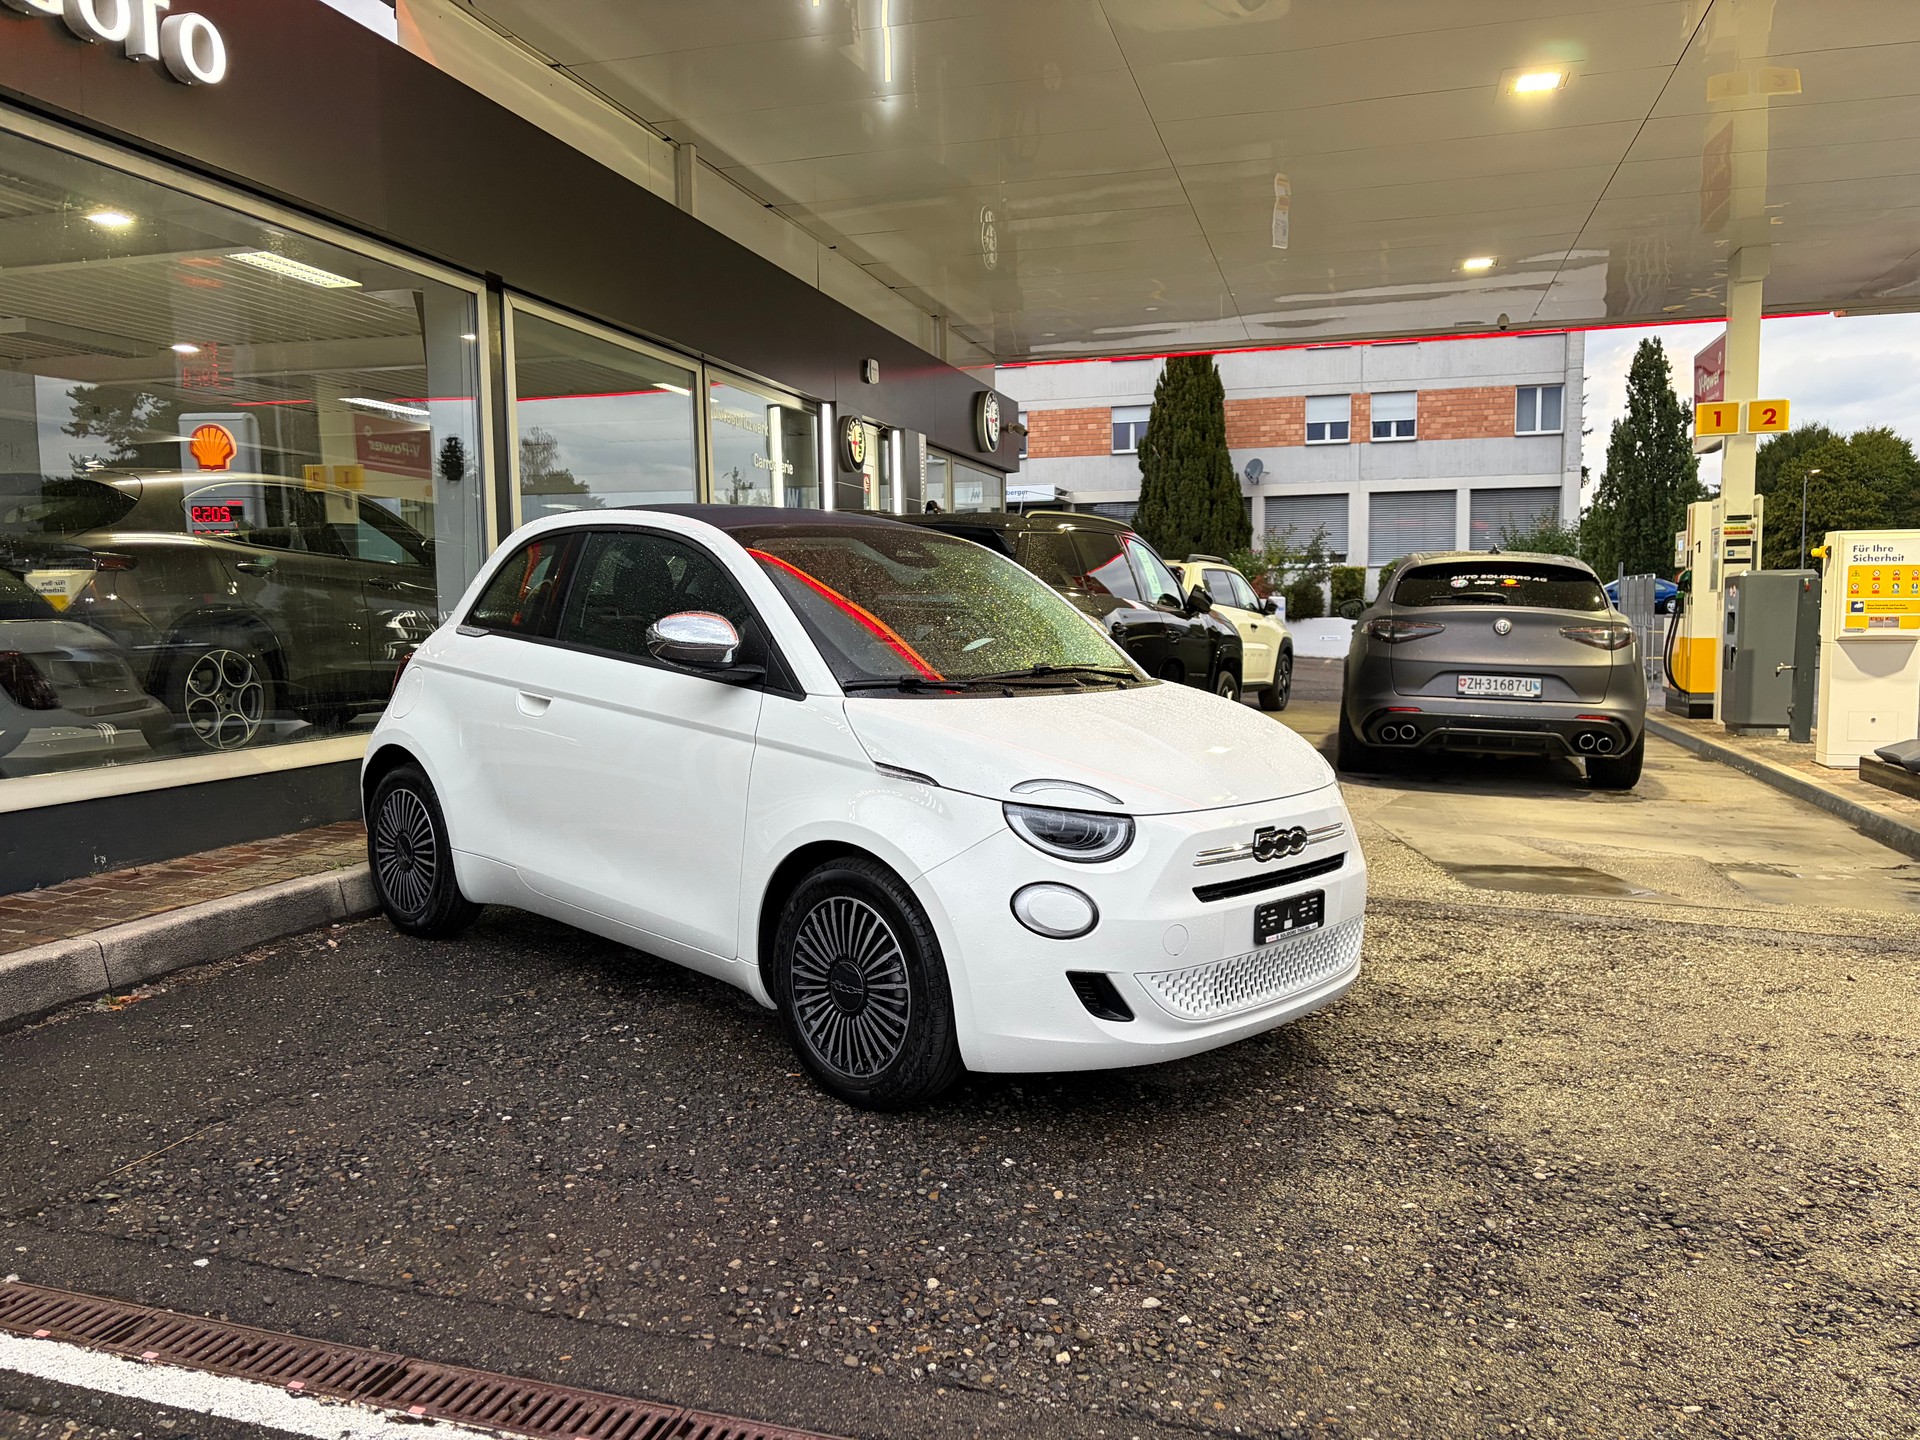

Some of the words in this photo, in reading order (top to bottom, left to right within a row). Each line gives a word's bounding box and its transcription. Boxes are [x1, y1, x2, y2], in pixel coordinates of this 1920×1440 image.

[1713, 410, 1721, 427] 1
[1762, 407, 1777, 426] 2
[753, 452, 794, 475] Carroerie
[1695, 540, 1702, 553] 1
[1853, 544, 1870, 553] Für
[1873, 544, 1894, 552] Ihre
[1853, 554, 1905, 562] Sicherheit
[1253, 826, 1307, 862] 500
